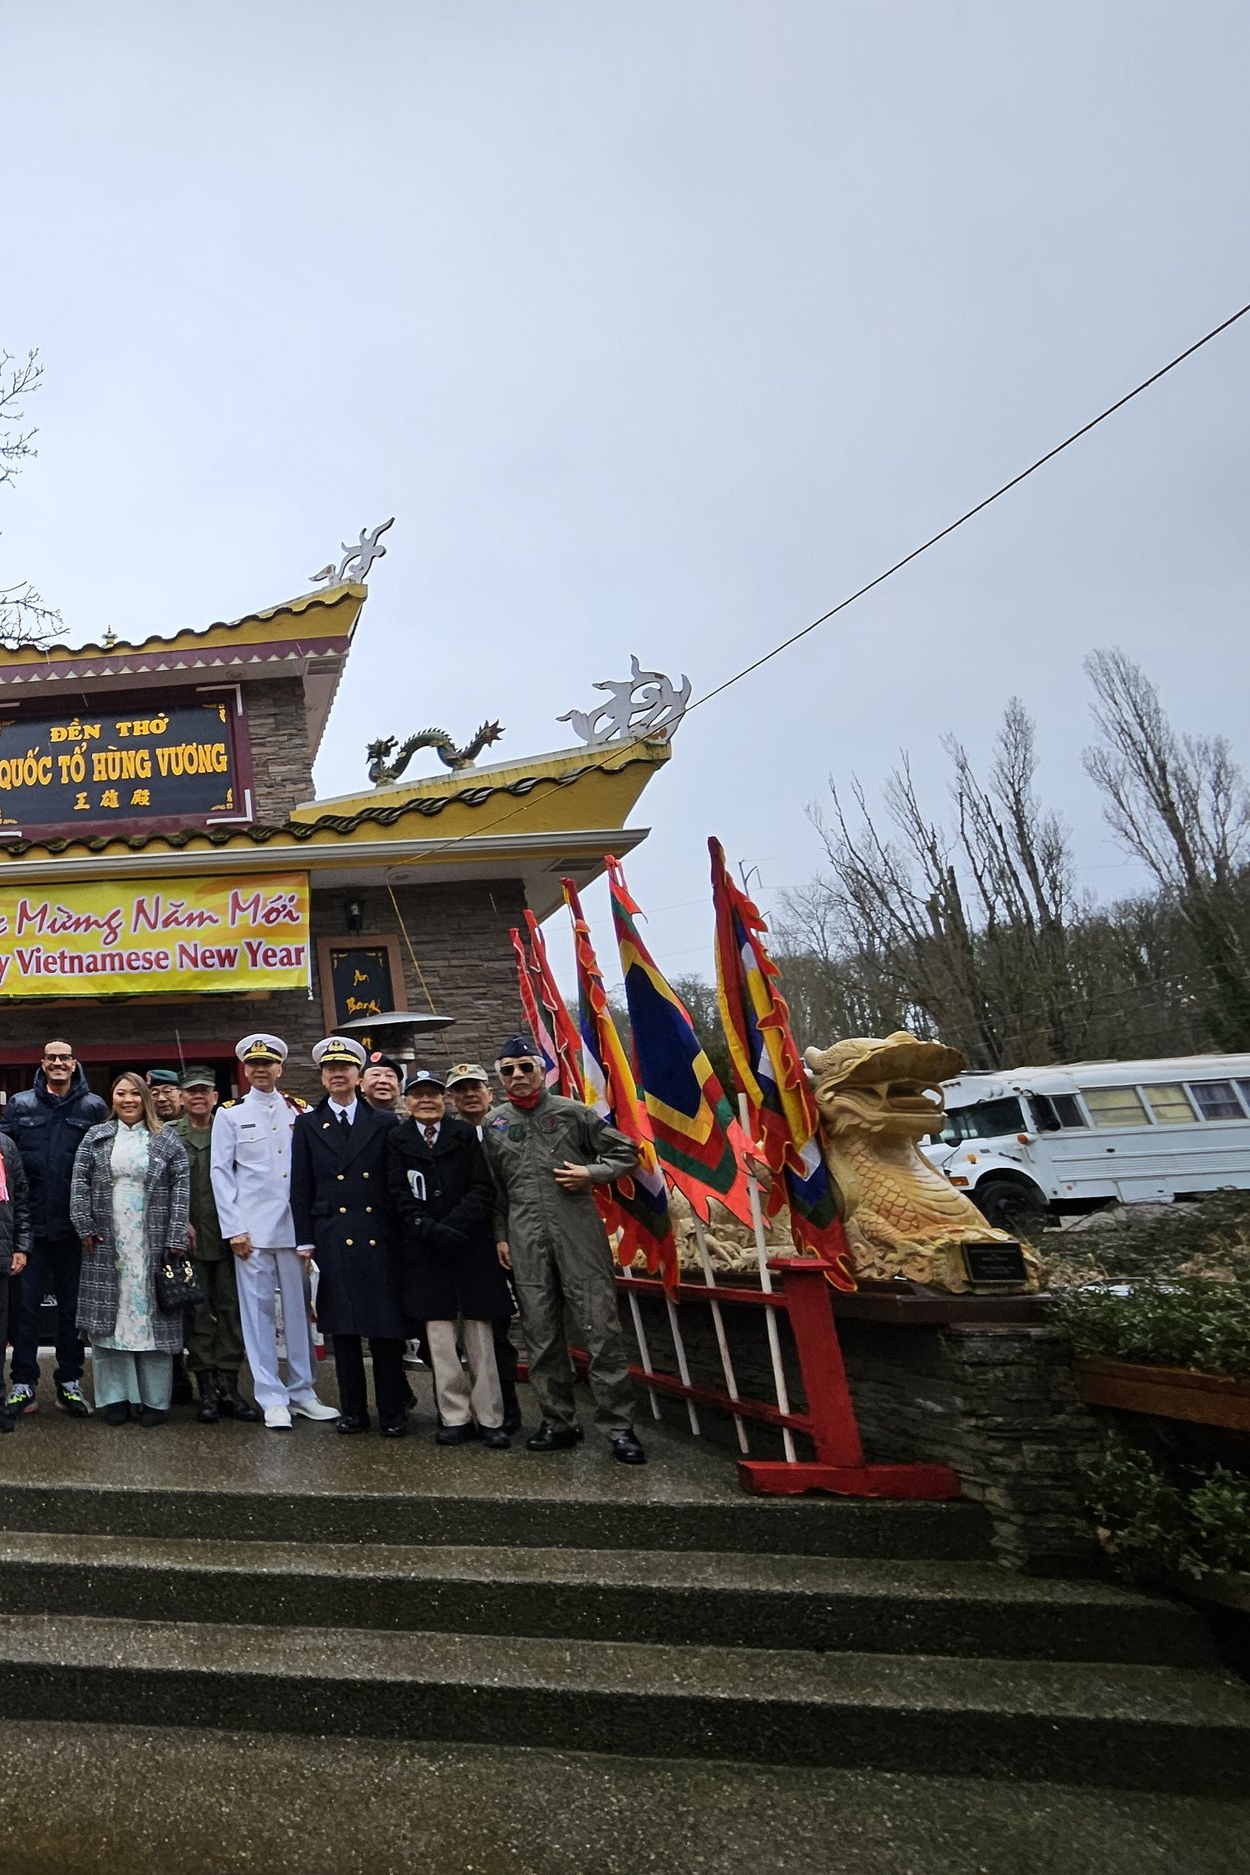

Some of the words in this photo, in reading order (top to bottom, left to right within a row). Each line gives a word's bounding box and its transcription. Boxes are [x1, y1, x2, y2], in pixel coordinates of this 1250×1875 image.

[50, 717, 101, 743] ĐỀN
[58, 742, 88, 784] TỔ
[91, 745, 152, 782] HÙNG
[155, 742, 229, 777] VƯƠNG
[16, 898, 124, 946] Mừng
[132, 894, 219, 933] Năm
[229, 888, 301, 927] Mới
[15, 946, 169, 976] Vietnamese
[177, 942, 238, 969] New
[244, 940, 305, 968] Year
